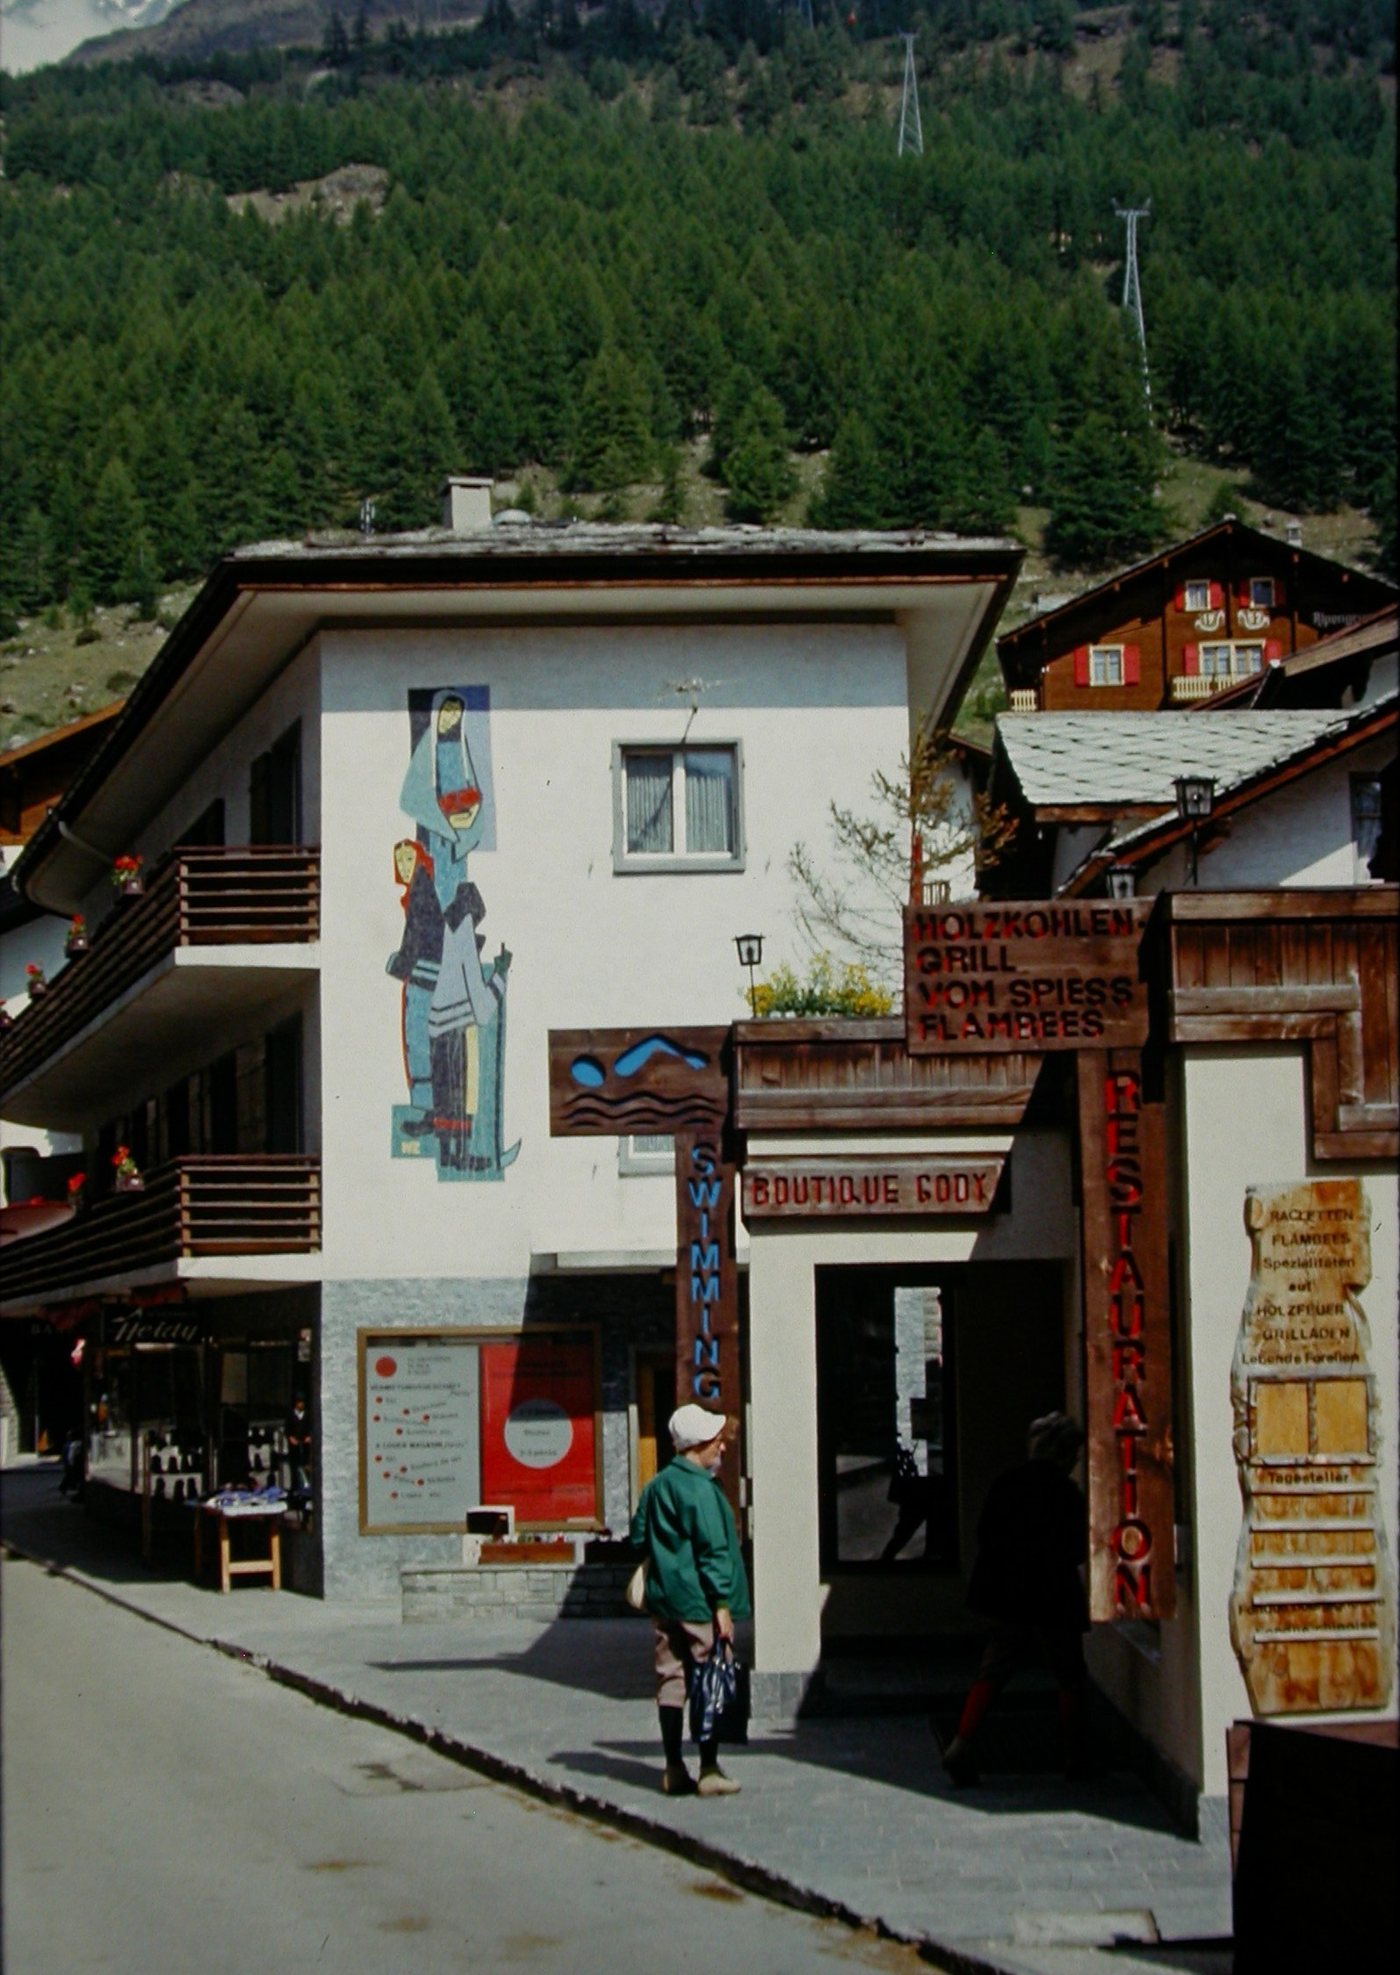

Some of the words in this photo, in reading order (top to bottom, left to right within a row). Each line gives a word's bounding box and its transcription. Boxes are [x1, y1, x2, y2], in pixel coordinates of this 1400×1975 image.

[916, 945, 1017, 976] GRILL
[918, 979, 996, 1009] VOM
[1009, 975, 1134, 1008] SPIESS
[917, 1010, 1105, 1042] FLAMBEES
[750, 1175, 900, 1206] BOUTIQUE
[916, 1173, 989, 1204] GODY
[687, 1141, 722, 1402] SWIMMING
[1104, 1070, 1151, 1612] RESTAURATION
